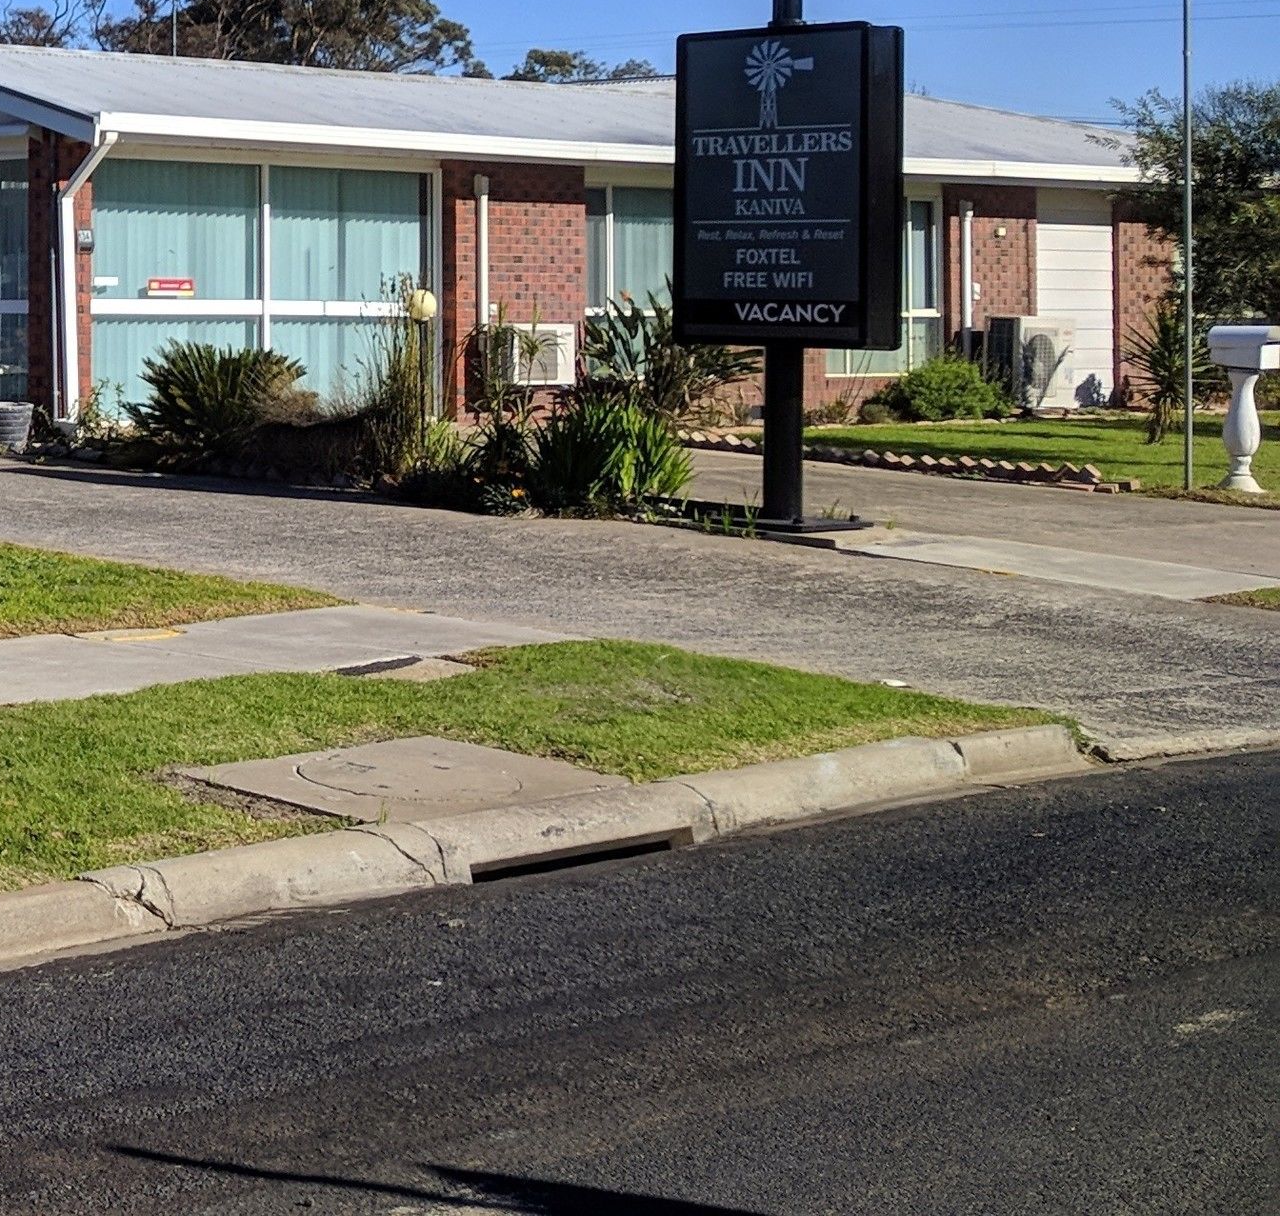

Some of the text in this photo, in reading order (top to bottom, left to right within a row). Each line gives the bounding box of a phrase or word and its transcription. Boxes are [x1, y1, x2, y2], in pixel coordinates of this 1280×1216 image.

[692, 131, 853, 156] TRAVELLERS
[732, 157, 808, 192] INN
[735, 198, 805, 216] KANIVA
[736, 248, 801, 265] FOXTEL
[723, 272, 813, 288] FREE WIFI
[734, 302, 846, 324] VACANCY
